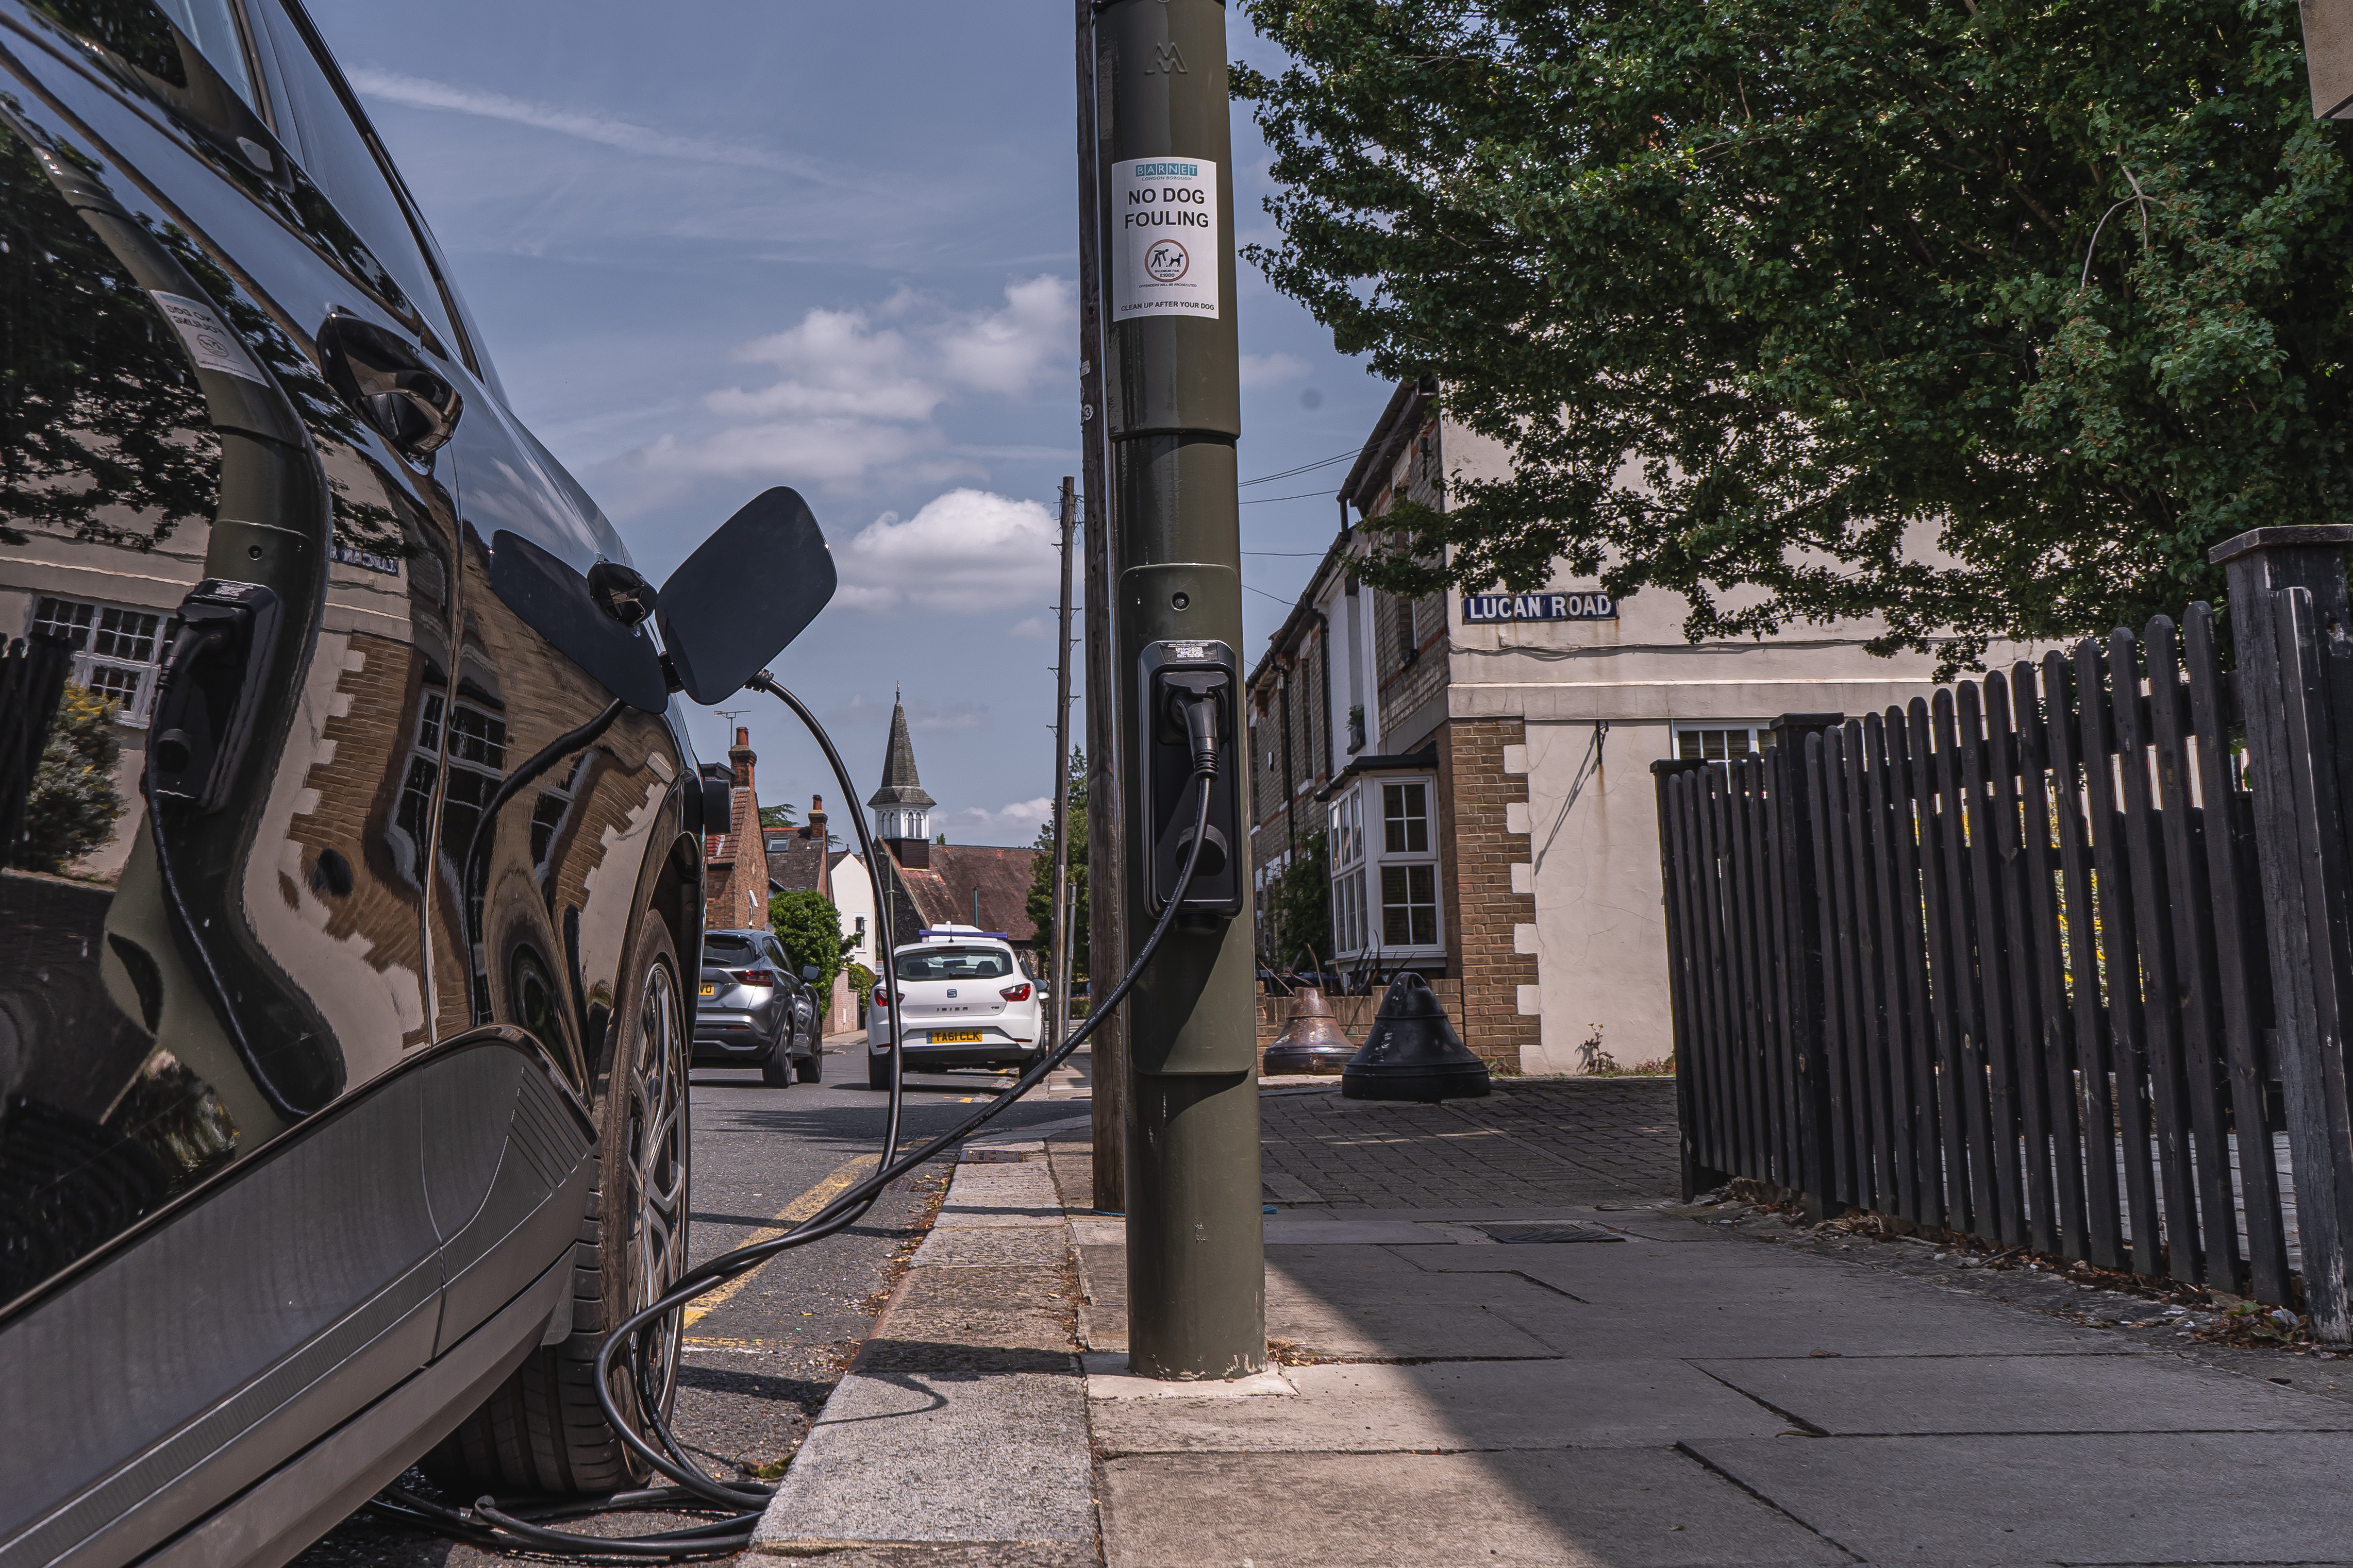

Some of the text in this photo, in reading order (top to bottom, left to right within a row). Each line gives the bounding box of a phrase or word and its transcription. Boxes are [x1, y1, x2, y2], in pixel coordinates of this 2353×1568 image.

[1137, 166, 1197, 175] BARNET
[1128, 188, 1205, 206] NO DOG
[1125, 210, 1209, 229] FOULING
[1121, 302, 1142, 312] CLEAN
[1470, 595, 1611, 618] LUCAN ROAD
[935, 1032, 979, 1041] TA61 CLK
